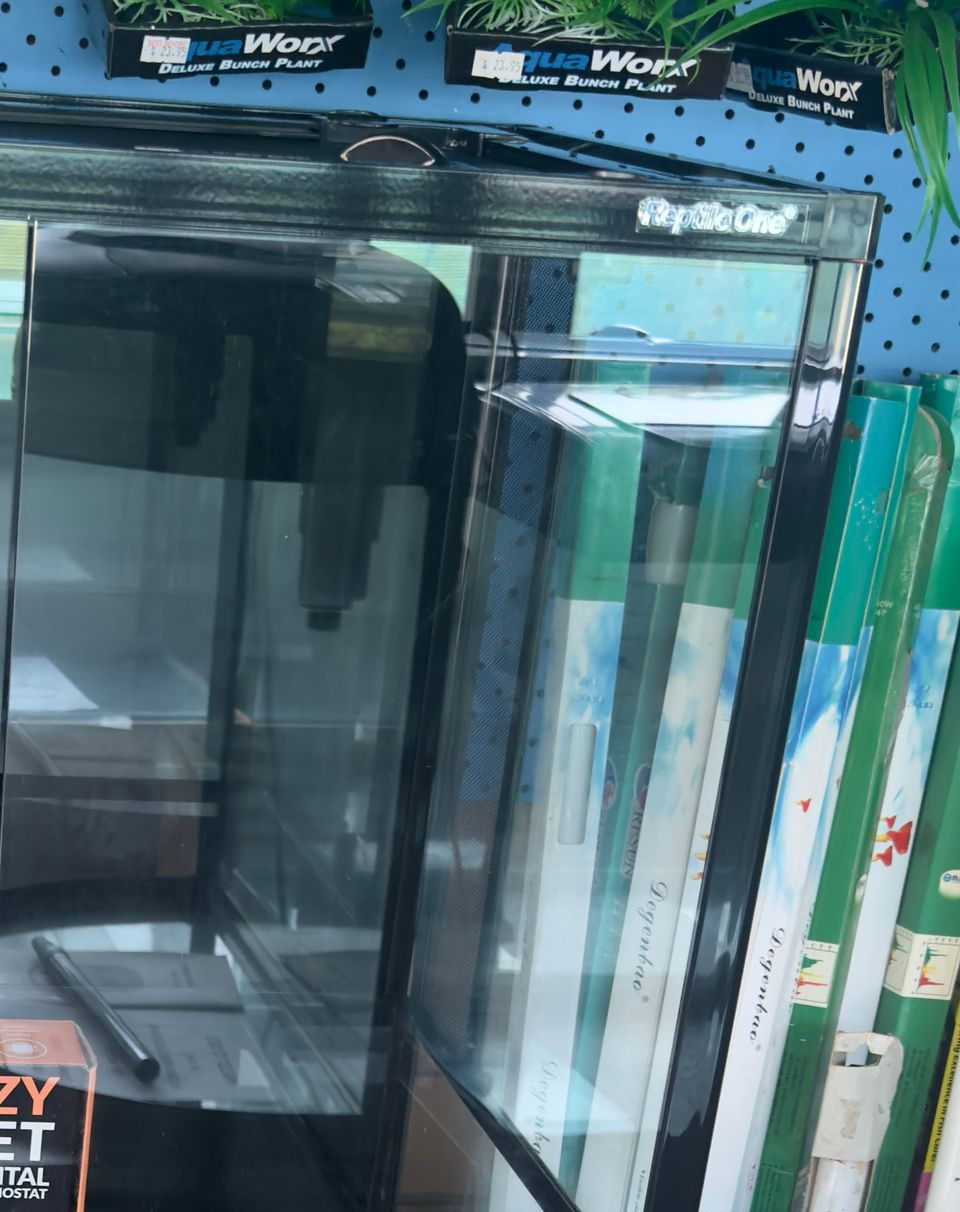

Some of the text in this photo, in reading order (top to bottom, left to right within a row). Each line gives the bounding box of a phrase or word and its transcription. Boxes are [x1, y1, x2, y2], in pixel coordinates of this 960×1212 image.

[157, 57, 324, 74] DELUXE BUNCH PLANT
[563, 74, 621, 89] BUNCH
[624, 79, 677, 94] PLANT
[748, 90, 855, 120] DELUXE BUNCH PLANT
